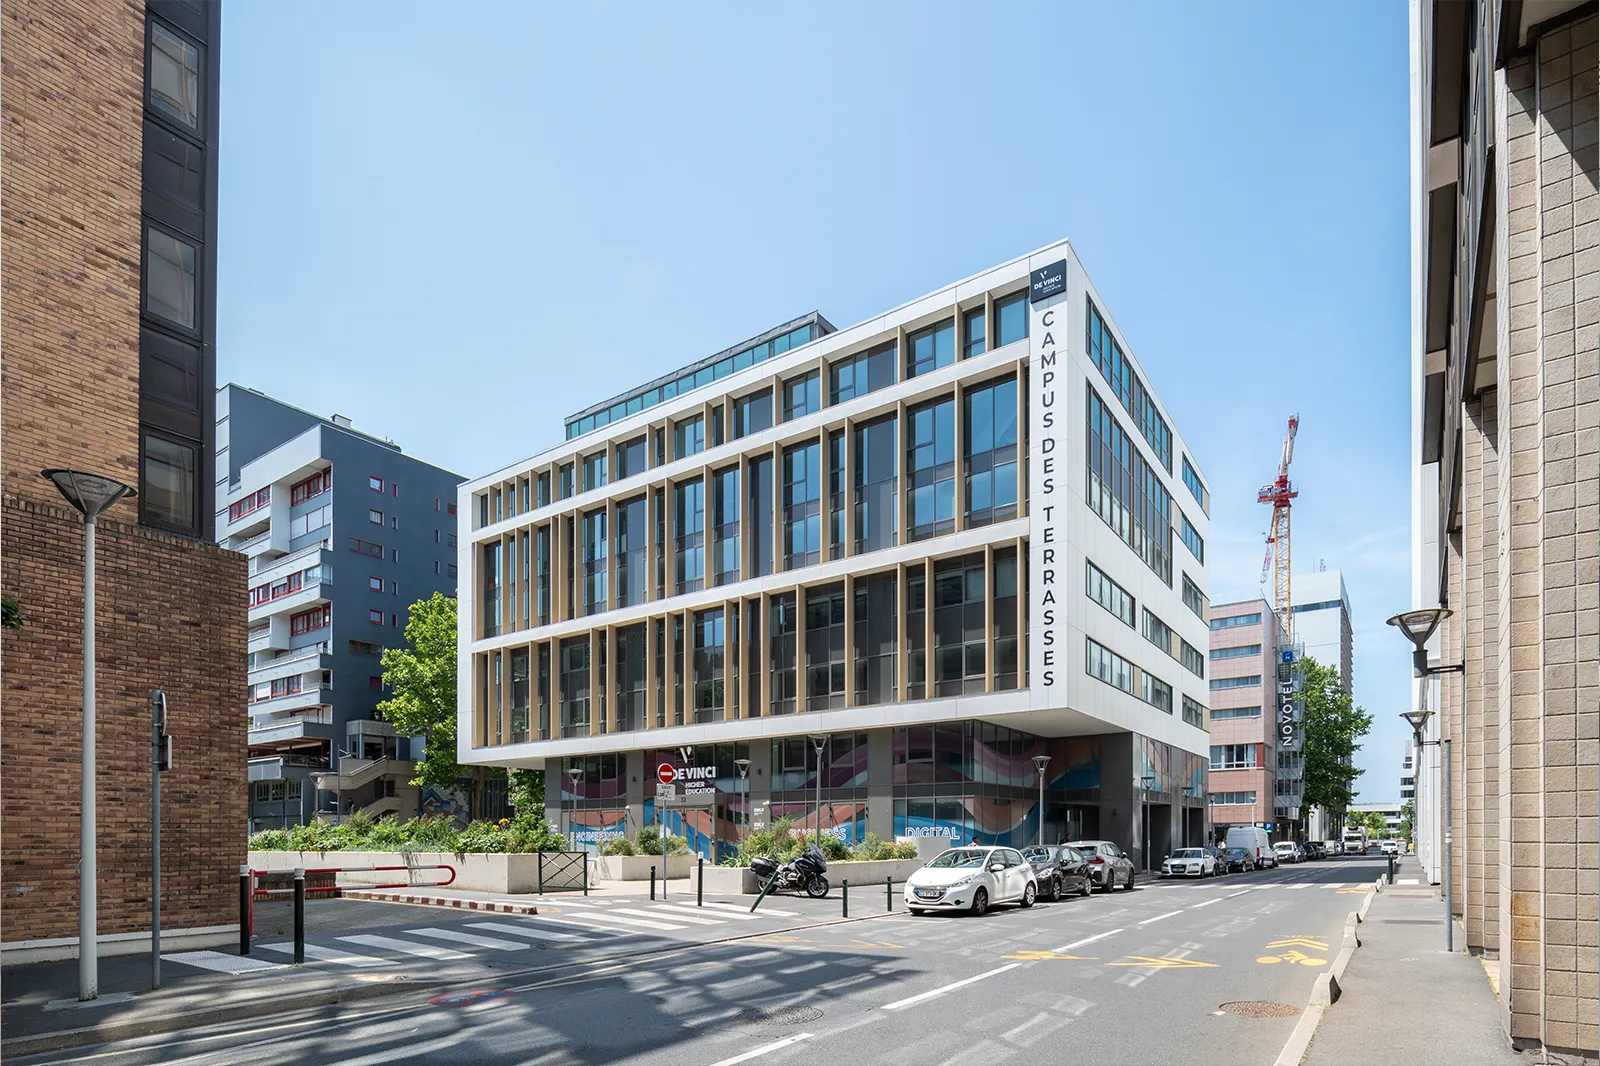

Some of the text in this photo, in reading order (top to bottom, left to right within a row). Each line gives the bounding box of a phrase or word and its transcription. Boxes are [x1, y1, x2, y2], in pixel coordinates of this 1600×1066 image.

[1034, 281, 1043, 290] DE
[1043, 274, 1062, 286] VINCI
[1041, 310, 1056, 687] CAMPUS DES TERRASSES
[1282, 677, 1293, 747] NOVOTEL
[685, 766, 717, 780] VINCI
[685, 787, 716, 795] EDUCATION
[905, 827, 960, 840] DIGITAL
